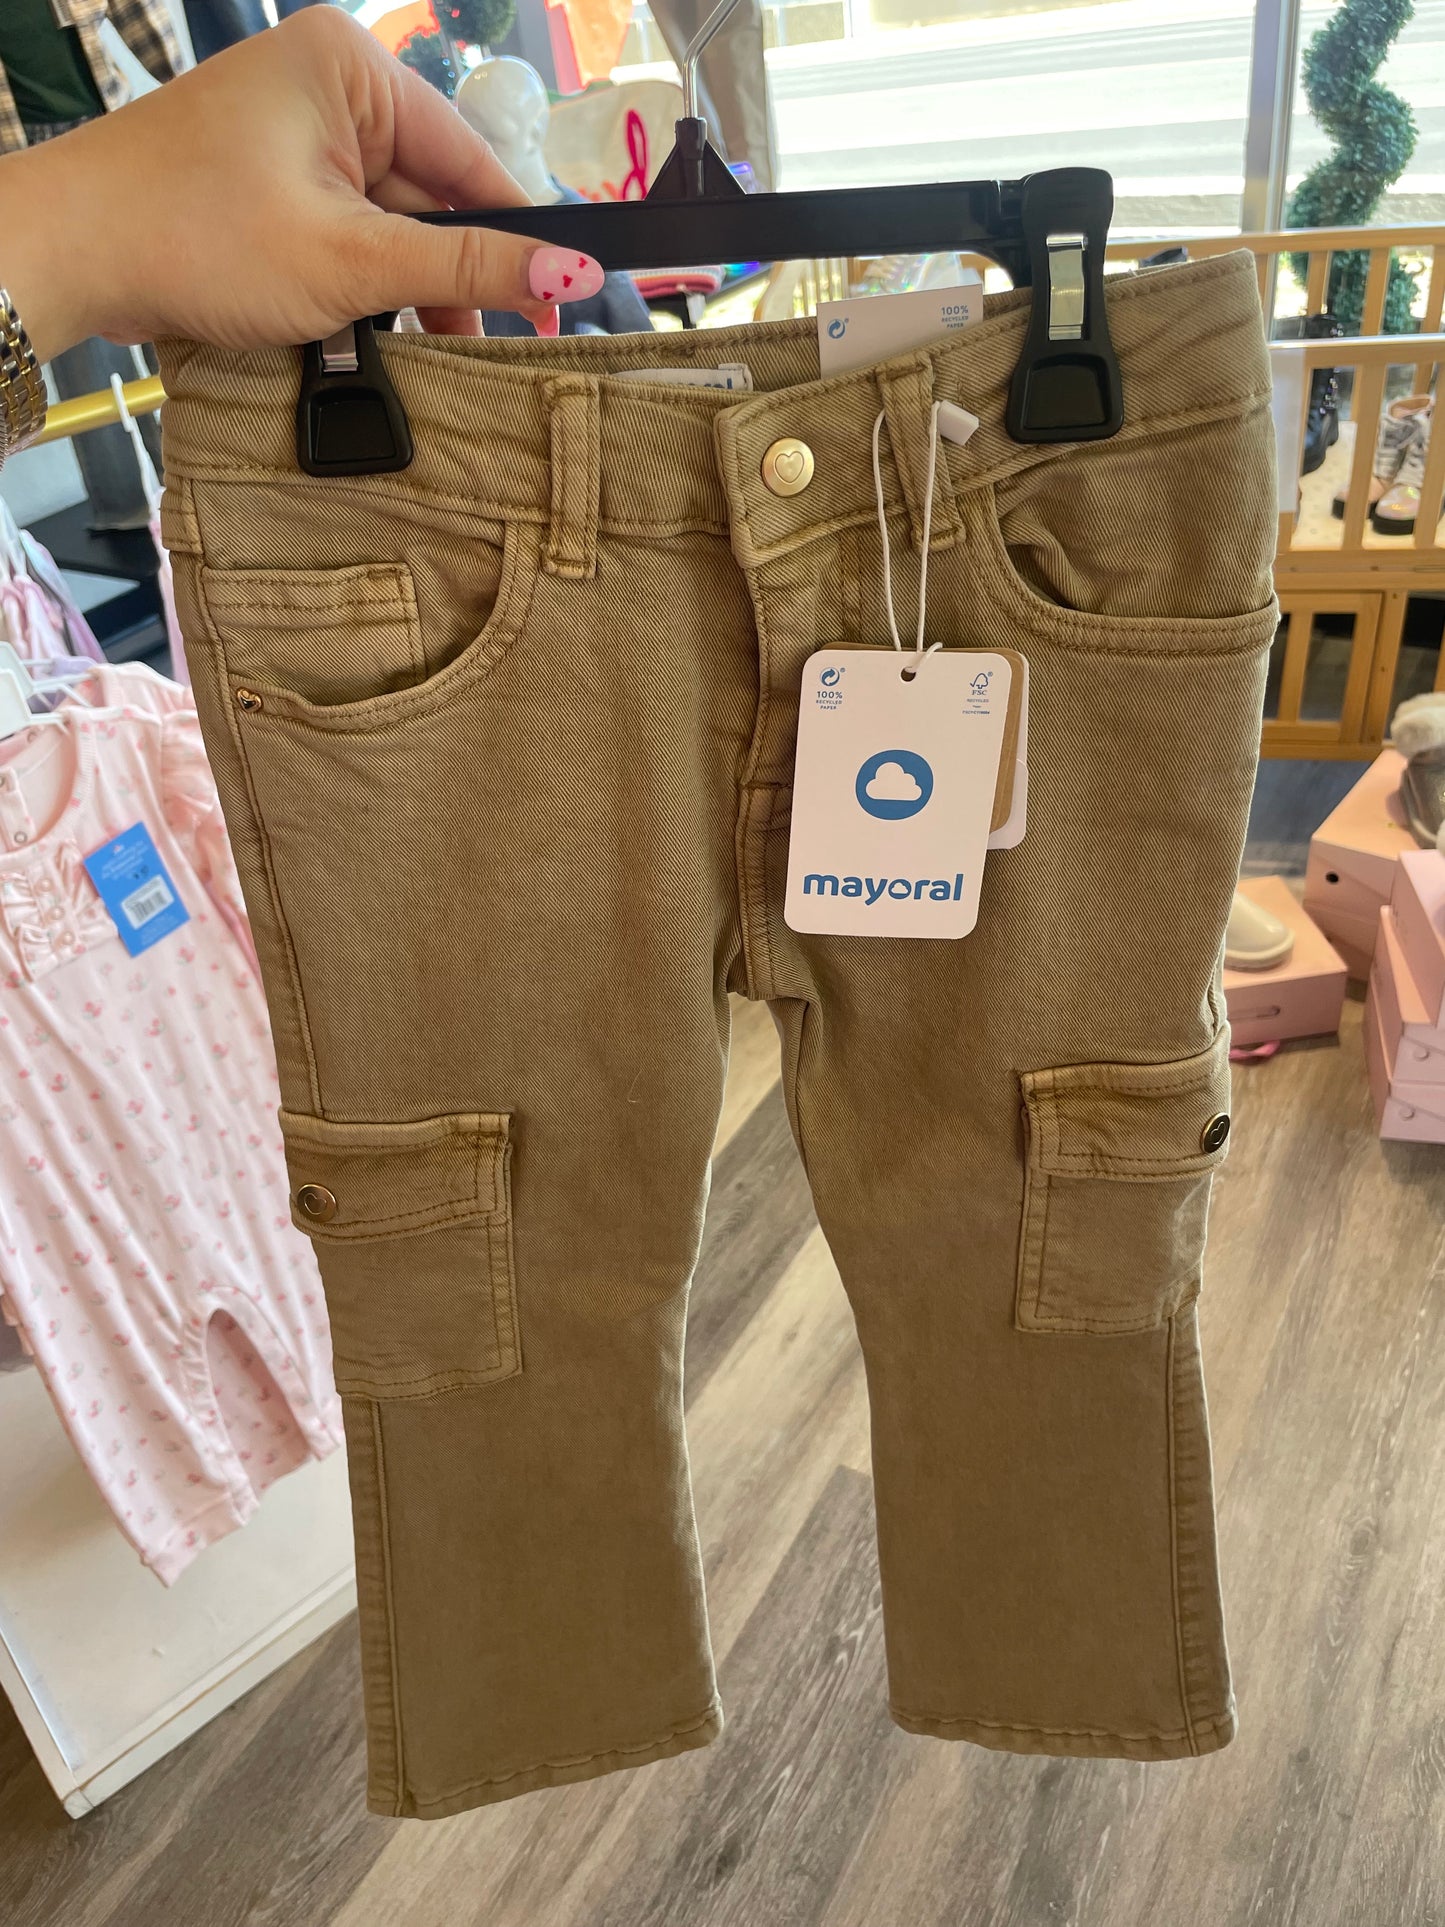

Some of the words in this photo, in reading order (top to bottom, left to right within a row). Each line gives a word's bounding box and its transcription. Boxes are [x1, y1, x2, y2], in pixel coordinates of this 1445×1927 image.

[941, 305, 969, 315] 100%
[817, 690, 843, 699] 100%
[803, 873, 964, 906] mayoral
